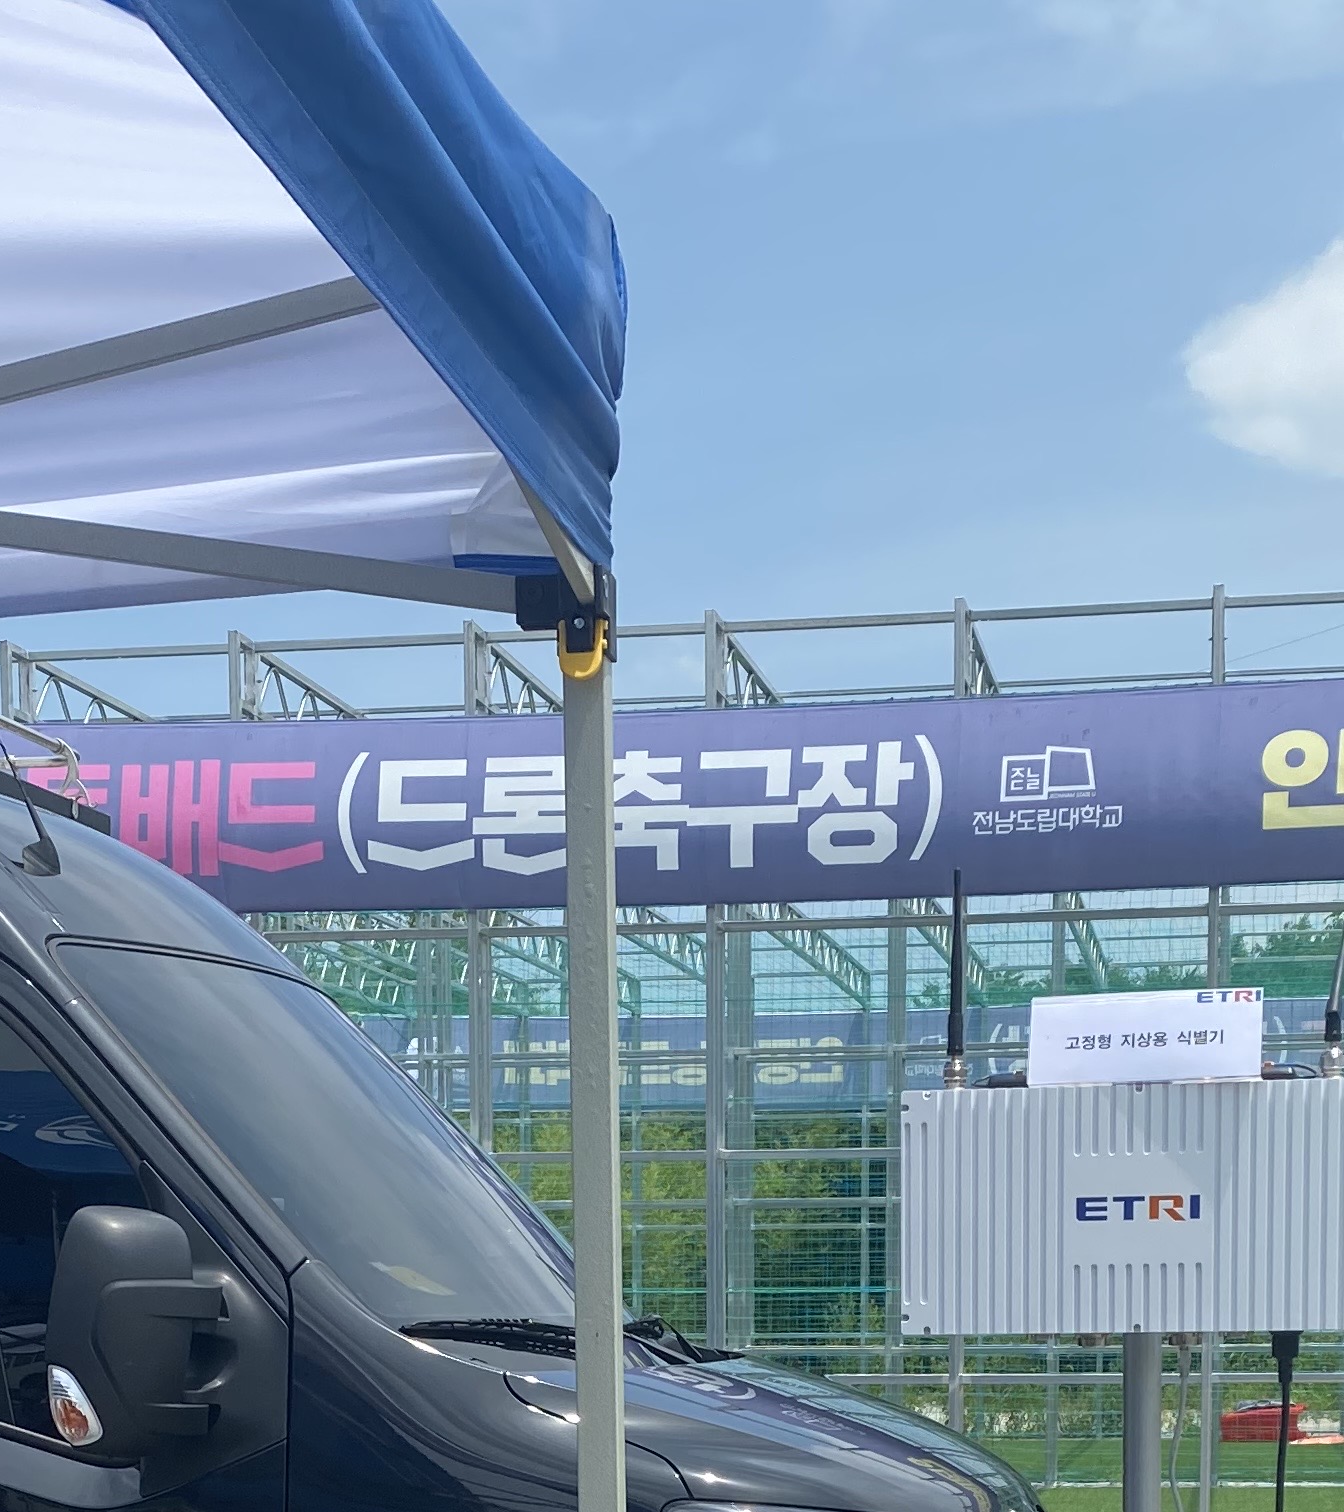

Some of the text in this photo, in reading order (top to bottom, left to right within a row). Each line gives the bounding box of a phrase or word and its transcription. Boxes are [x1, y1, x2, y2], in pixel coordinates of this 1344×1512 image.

[972, 804, 1124, 836] 전남도립대학교
[1196, 989, 1262, 1004] ETRI
[1064, 1028, 1225, 1051] 고정형 지상용 식별기
[1075, 1194, 1202, 1223] ETRI
